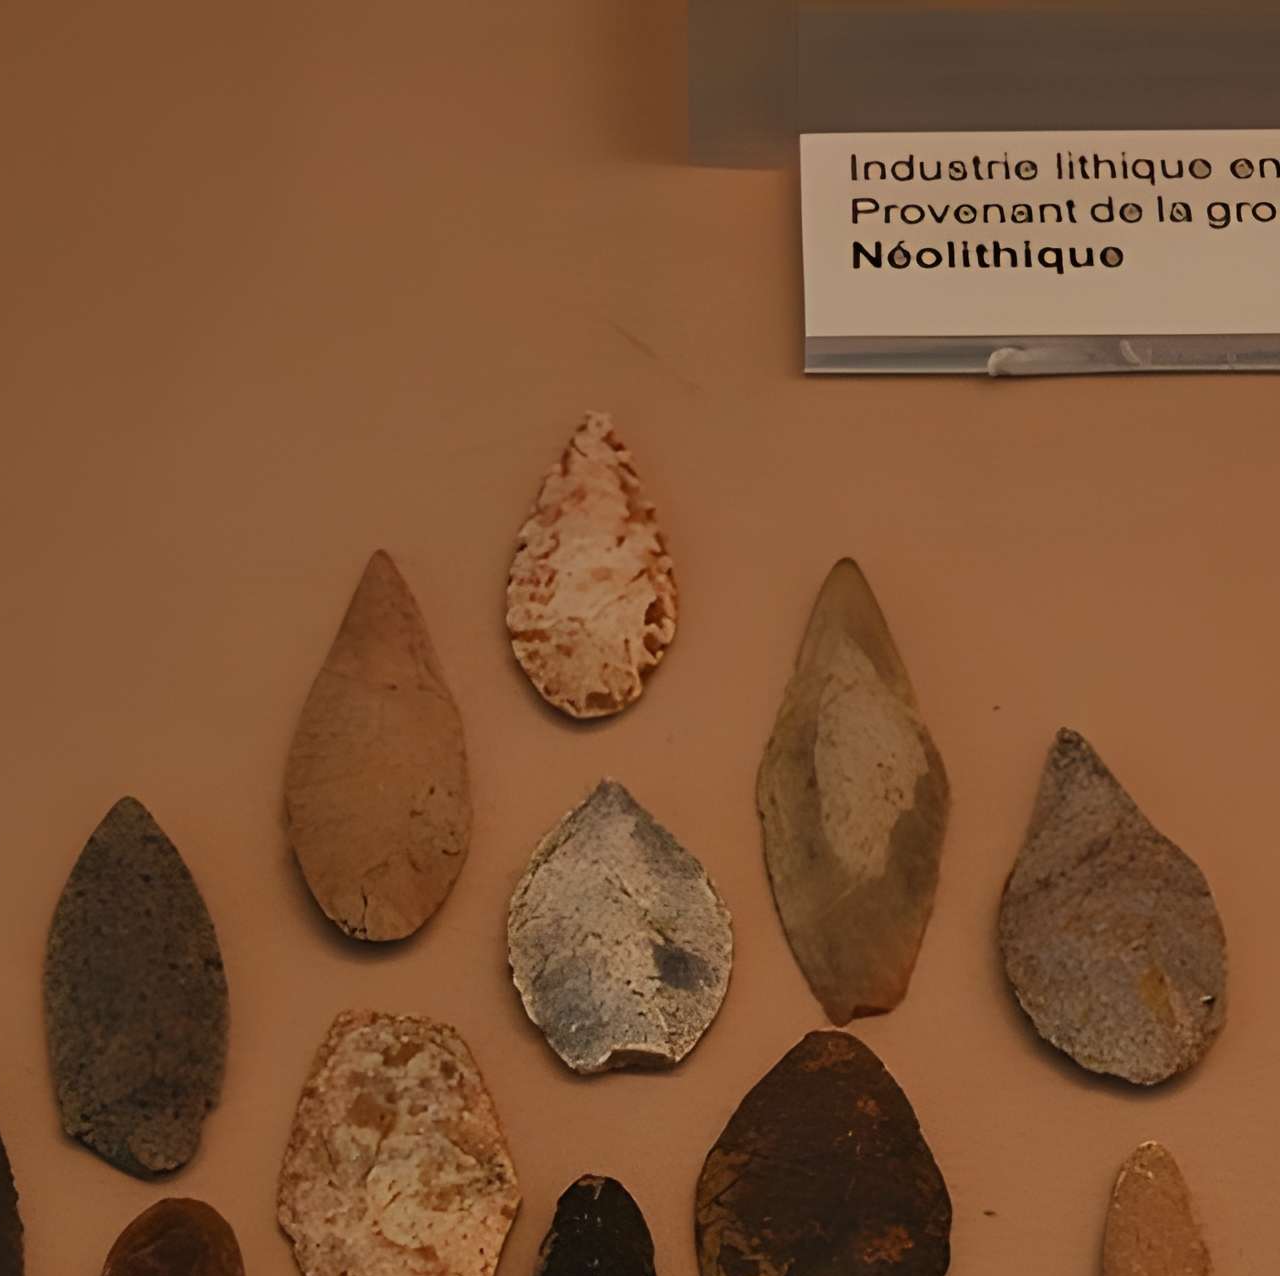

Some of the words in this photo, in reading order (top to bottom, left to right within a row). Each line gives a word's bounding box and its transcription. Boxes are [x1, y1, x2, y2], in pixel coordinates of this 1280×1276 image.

[850, 153, 1038, 182] Industrie
[1056, 152, 1212, 186] lithique
[851, 197, 1077, 225] Provenant
[1090, 195, 1143, 224] de
[1156, 195, 1193, 223] la
[852, 240, 1124, 275] Néolithique
